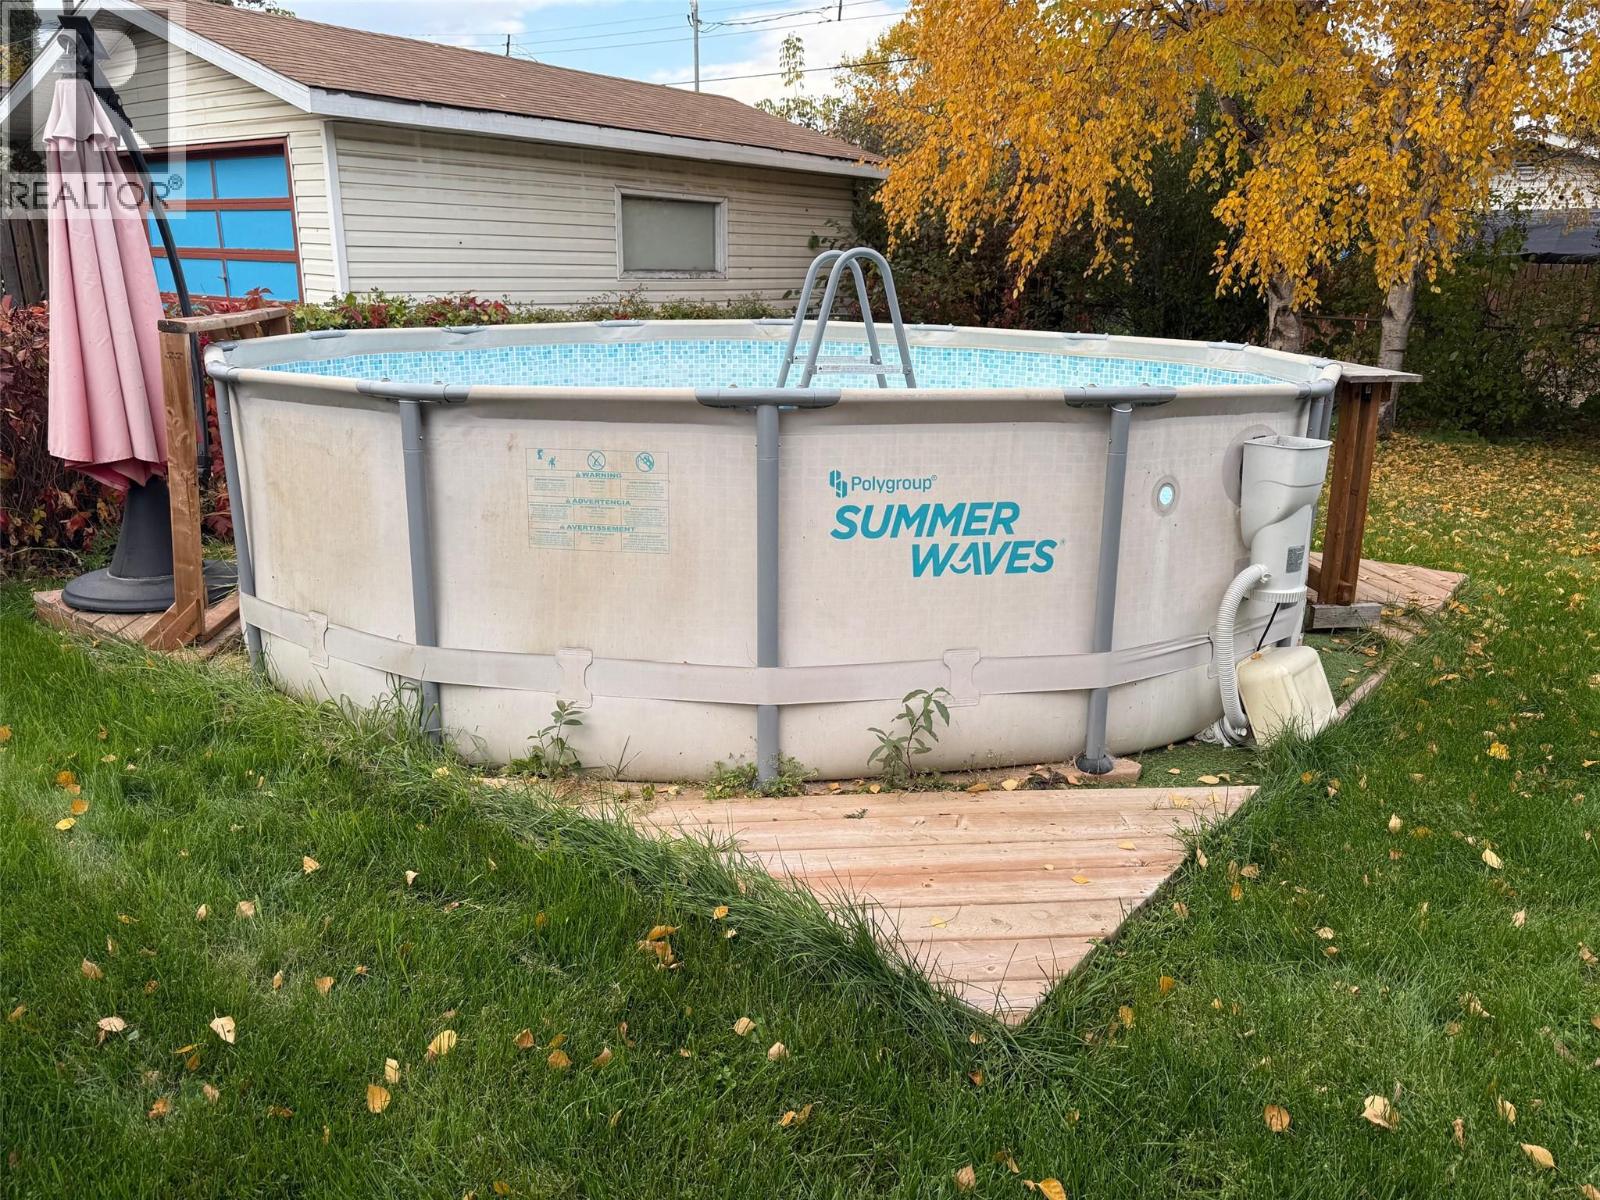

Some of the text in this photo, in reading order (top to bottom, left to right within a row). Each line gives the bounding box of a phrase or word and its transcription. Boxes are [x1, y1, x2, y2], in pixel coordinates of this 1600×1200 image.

[851, 474, 938, 493] Polygroup®
[572, 498, 631, 506] ADVERTENCIA
[566, 524, 635, 532] AVERTISSEMENT
[830, 502, 1021, 540] SUMMER
[911, 539, 1058, 578] WAVES
